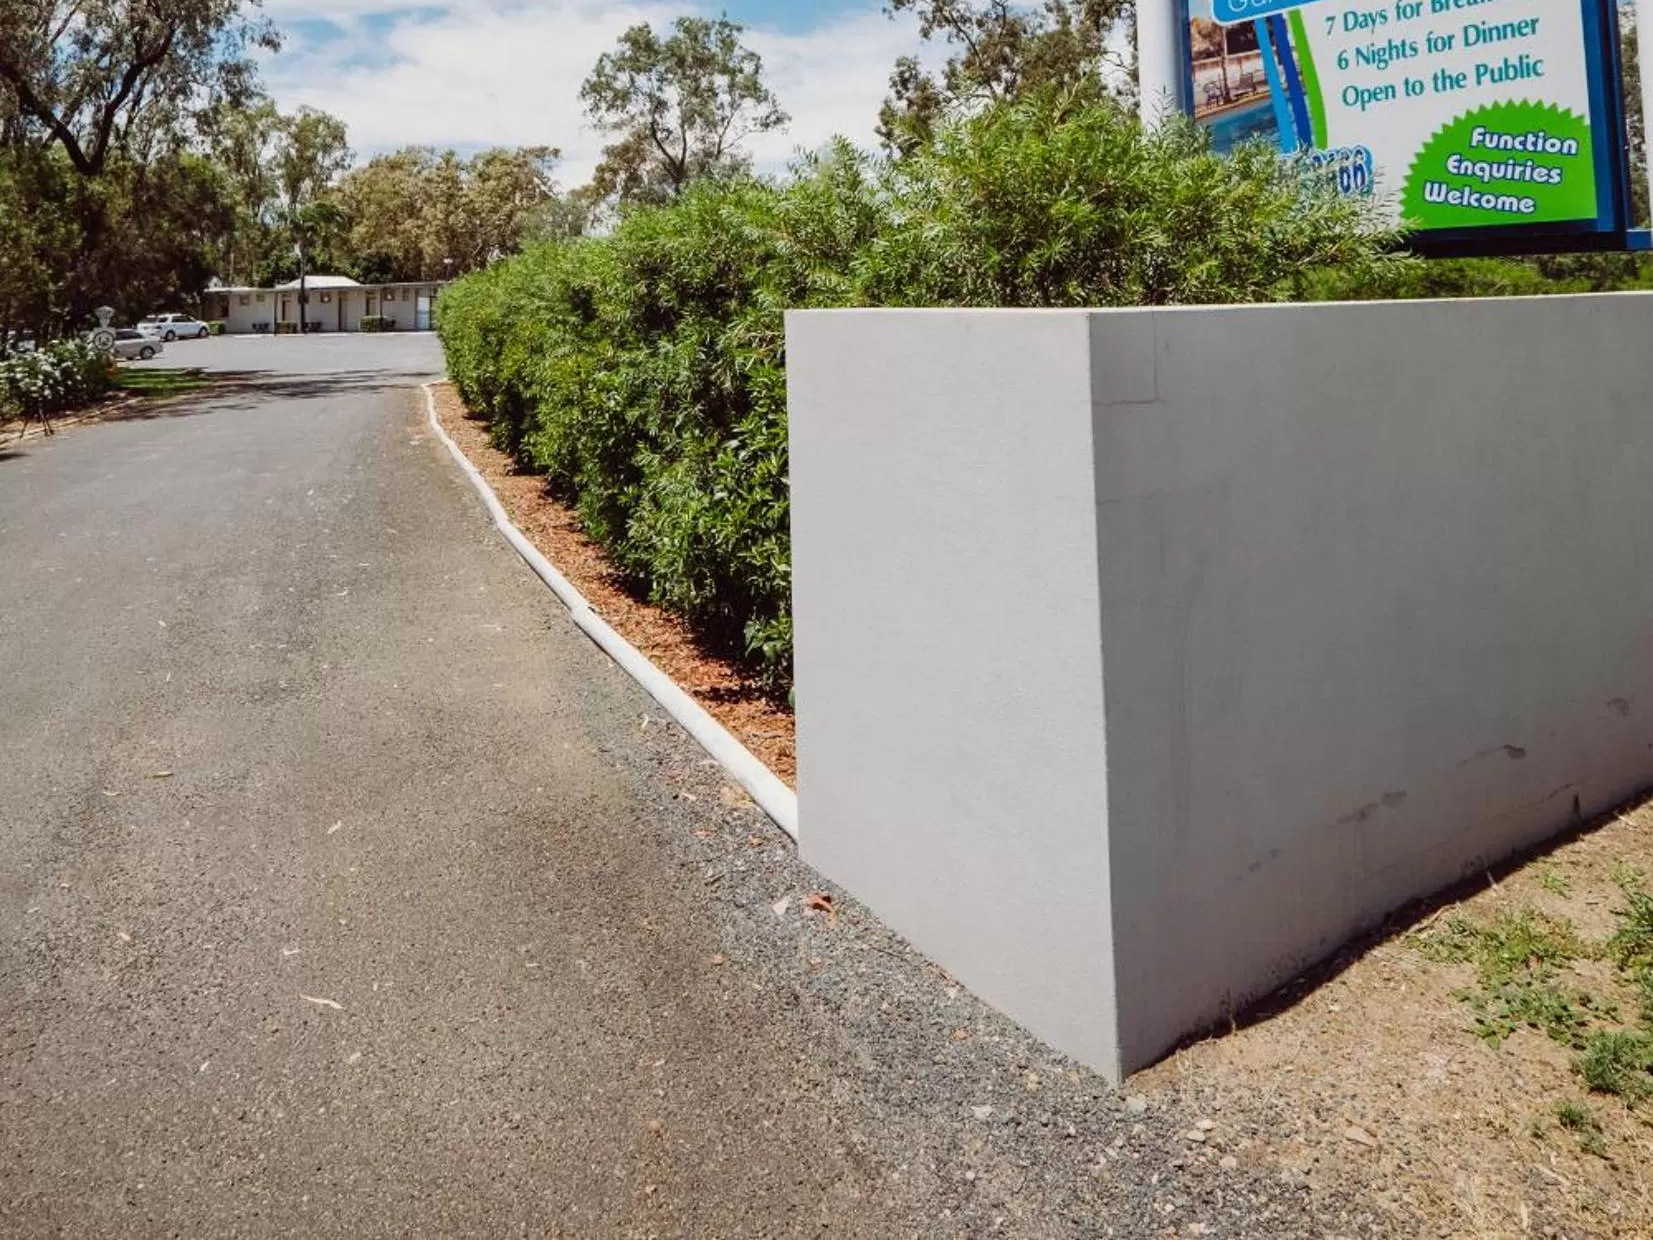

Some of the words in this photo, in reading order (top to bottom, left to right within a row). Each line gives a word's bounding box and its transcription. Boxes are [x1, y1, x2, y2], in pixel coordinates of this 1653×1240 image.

[1325, 15, 1337, 37] 7
[1343, 8, 1388, 35] Days
[1337, 48, 1349, 71] 6
[1355, 38, 1419, 72] Nights
[1426, 30, 1455, 54] for
[1463, 16, 1540, 48] Dinner
[1342, 83, 1397, 112] Open
[1403, 76, 1425, 97] to
[1433, 67, 1468, 93] the
[1475, 53, 1545, 86] Public
[1470, 125, 1579, 155] Function
[1446, 153, 1563, 184] Enquiries
[1424, 180, 1536, 213] Welcome
